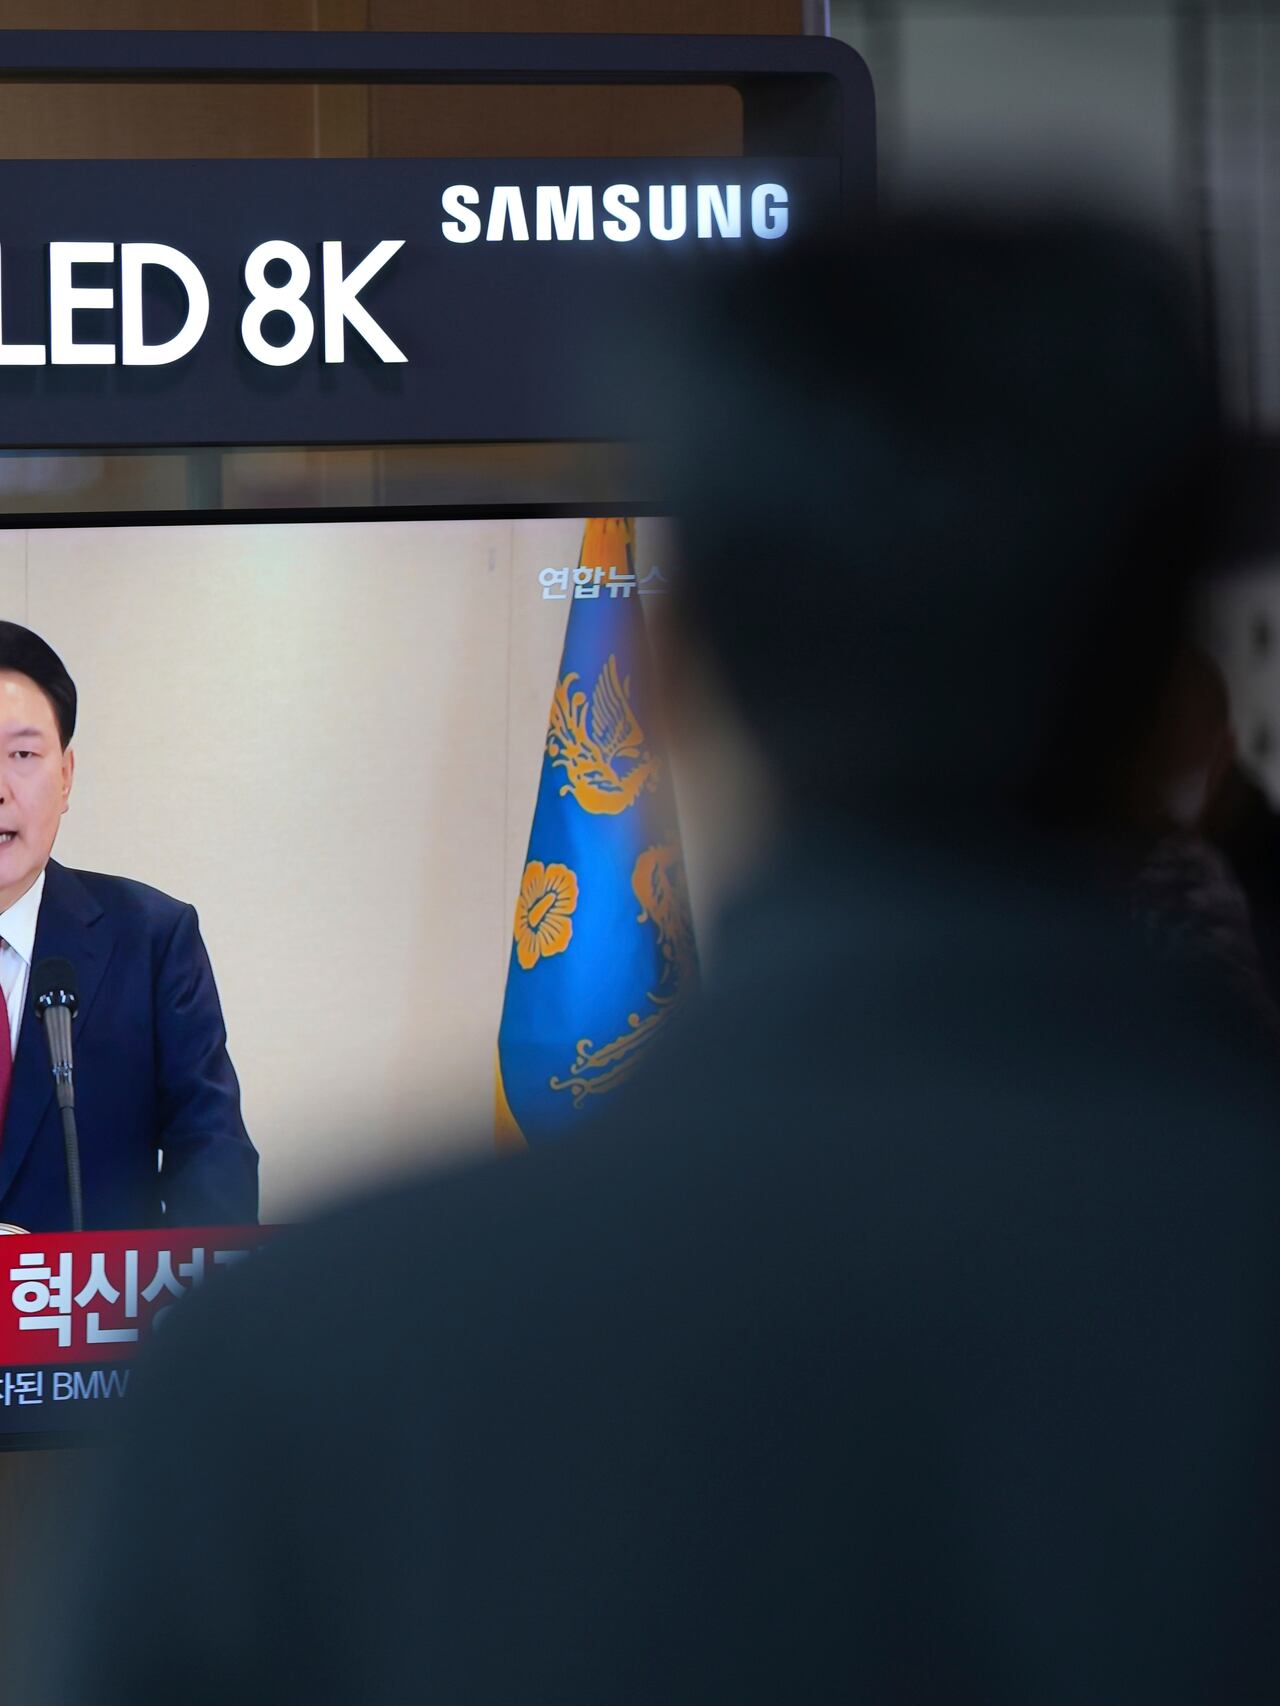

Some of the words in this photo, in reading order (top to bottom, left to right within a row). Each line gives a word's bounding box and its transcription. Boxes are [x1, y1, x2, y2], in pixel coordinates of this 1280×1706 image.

[441, 183, 789, 244] SAMSUNG
[241, 240, 409, 368] 8K
[53, 1369, 130, 1401] BMW
